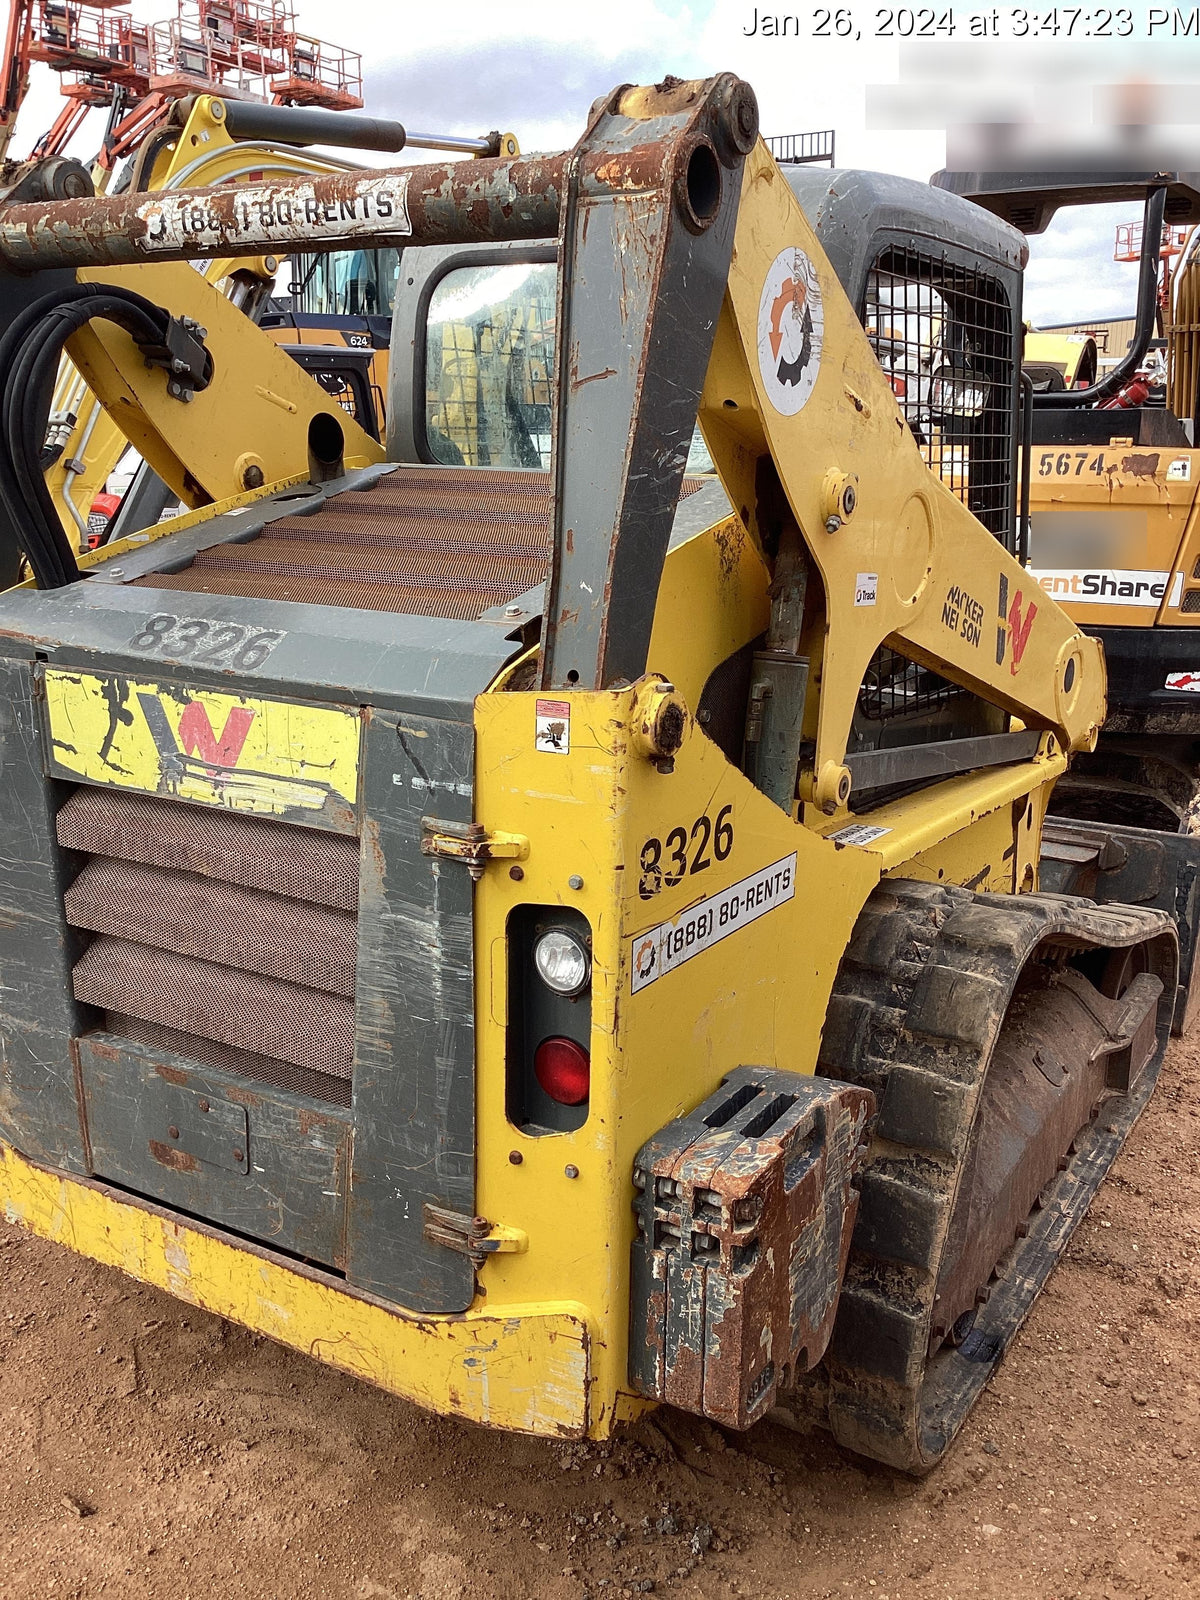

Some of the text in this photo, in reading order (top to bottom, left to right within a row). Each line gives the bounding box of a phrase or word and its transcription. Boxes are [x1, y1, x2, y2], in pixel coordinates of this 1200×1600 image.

[350, 336, 368, 346] 624
[1038, 453, 1105, 476] 5674
[1032, 573, 1165, 599] entShare
[129, 615, 282, 671] 8326
[638, 804, 734, 901] 8326
[666, 867, 791, 960] (888) 80-RENTS
